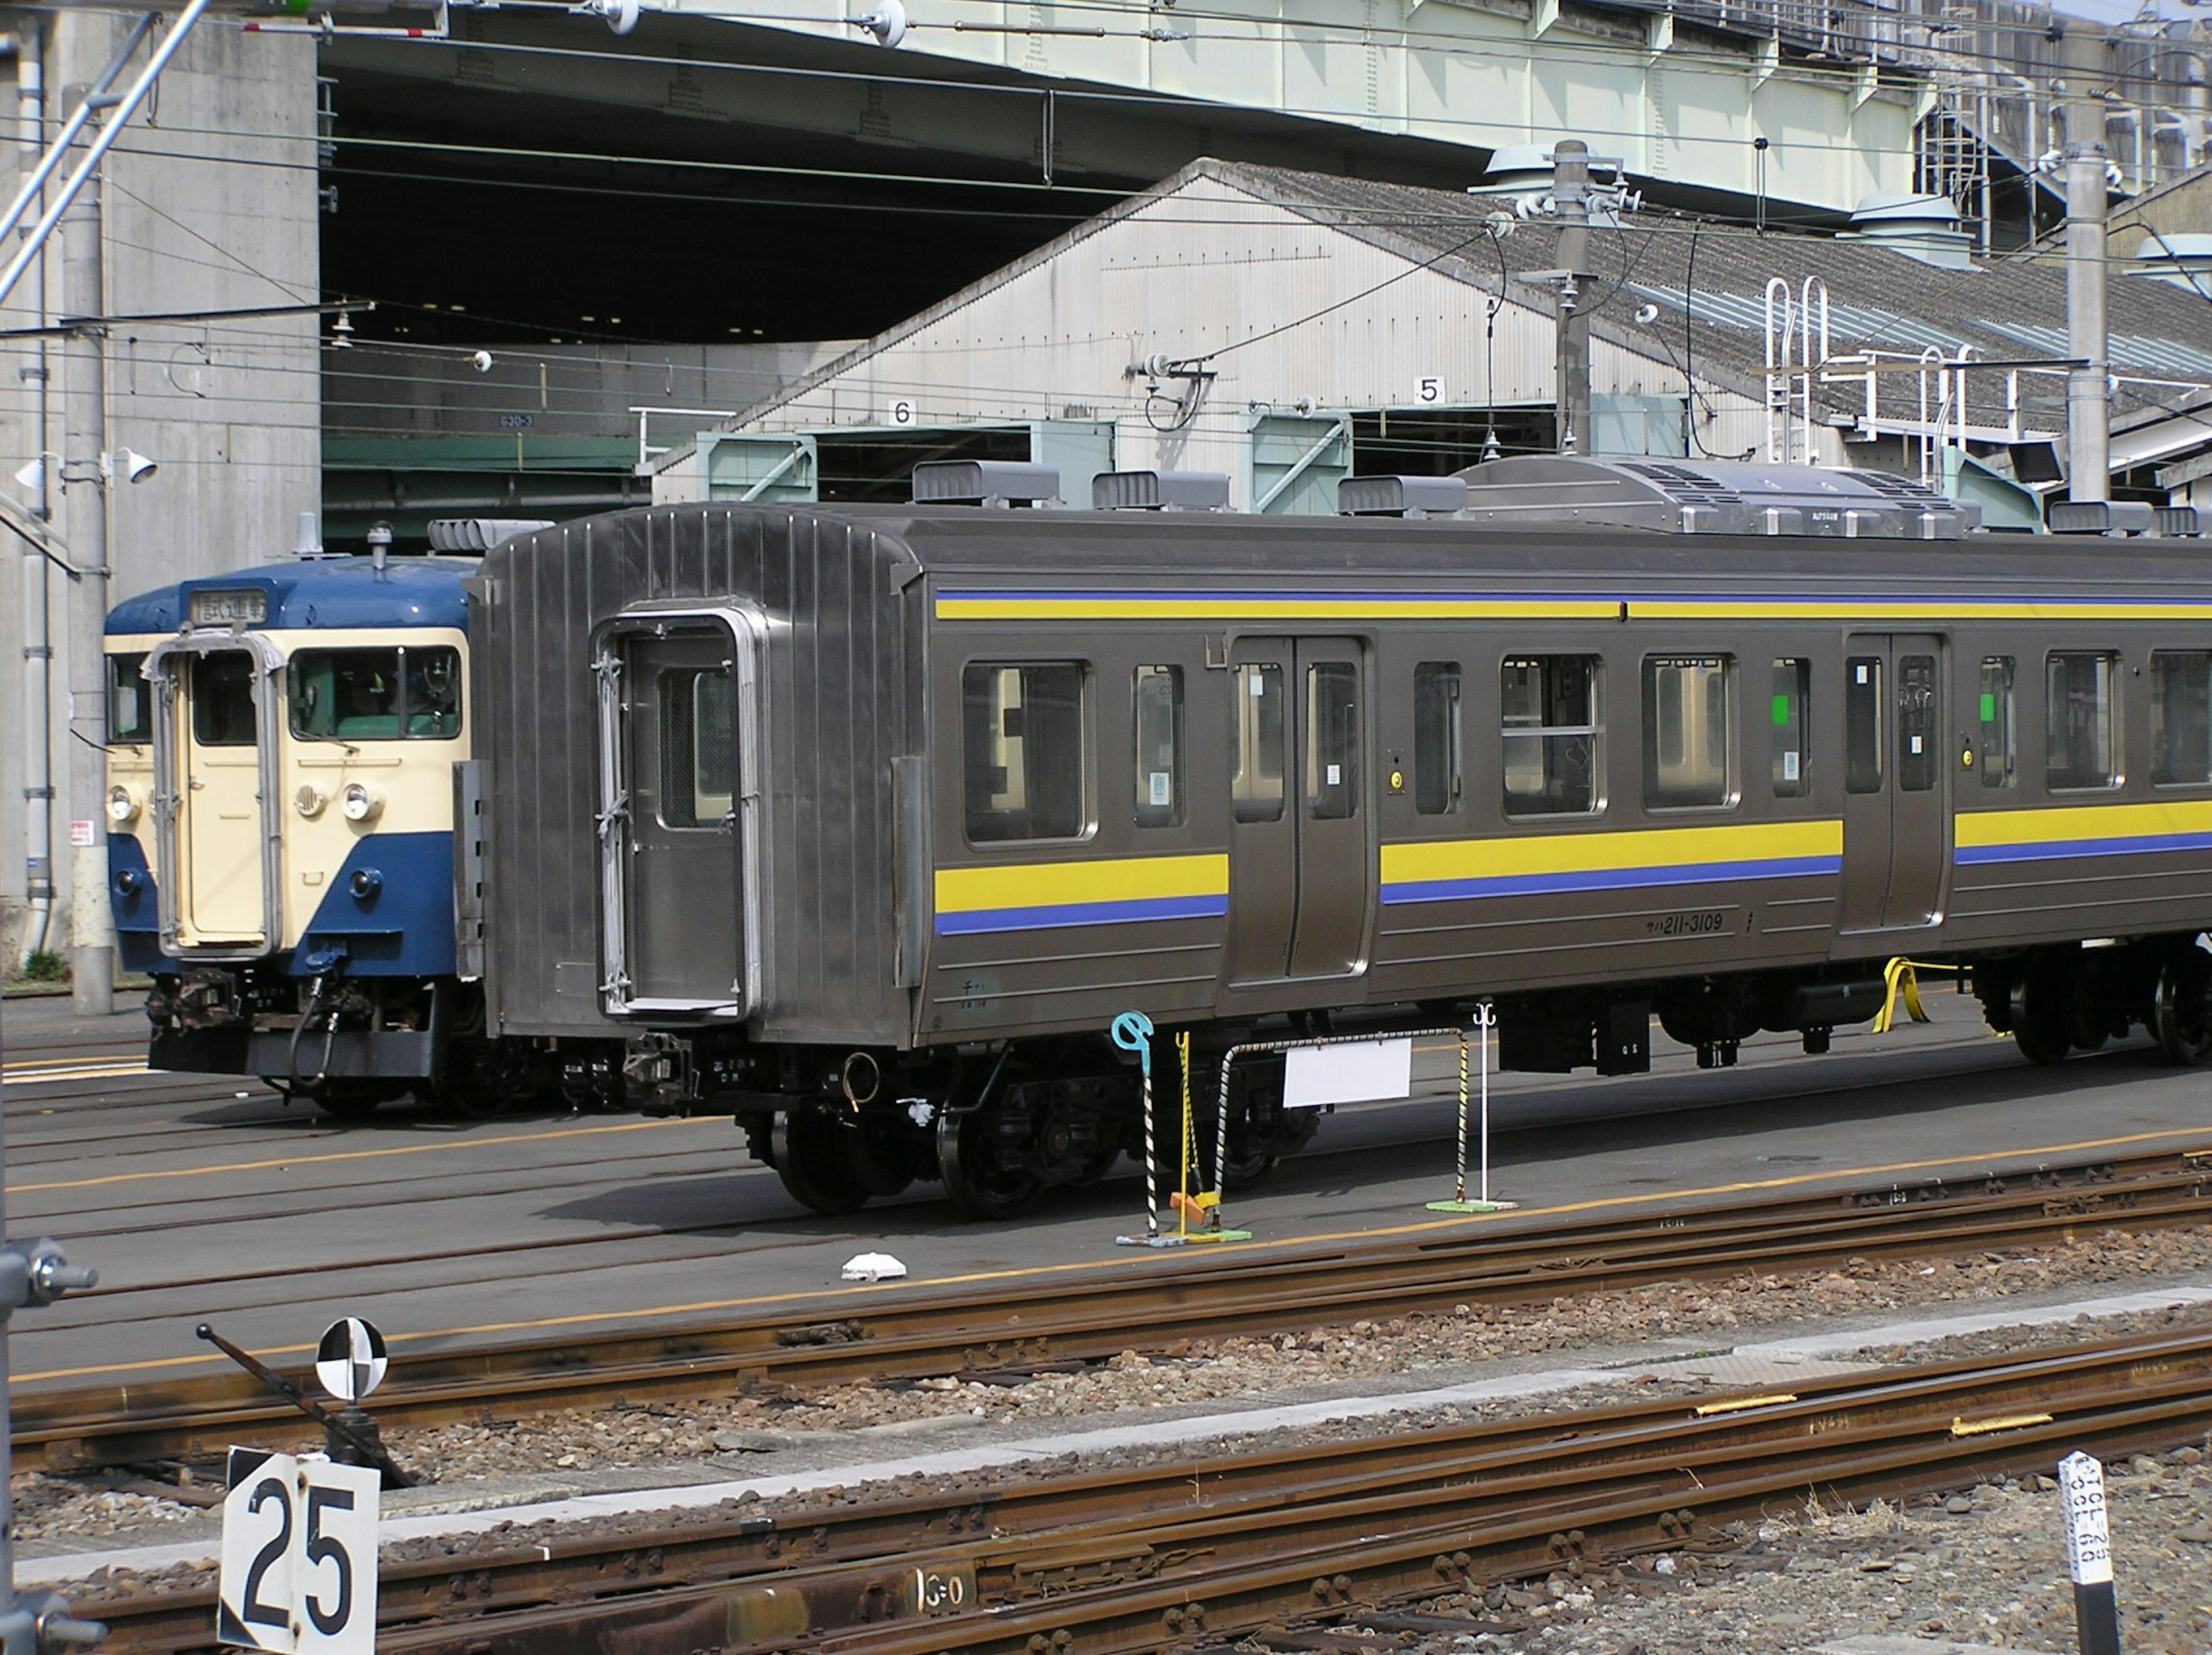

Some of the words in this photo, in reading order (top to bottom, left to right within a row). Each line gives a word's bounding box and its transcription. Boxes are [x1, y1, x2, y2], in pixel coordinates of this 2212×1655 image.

[1421, 379, 1437, 402] 5
[895, 402, 909, 423] 6
[203, 594, 267, 620] 試運転
[243, 1477, 355, 1636] 25
